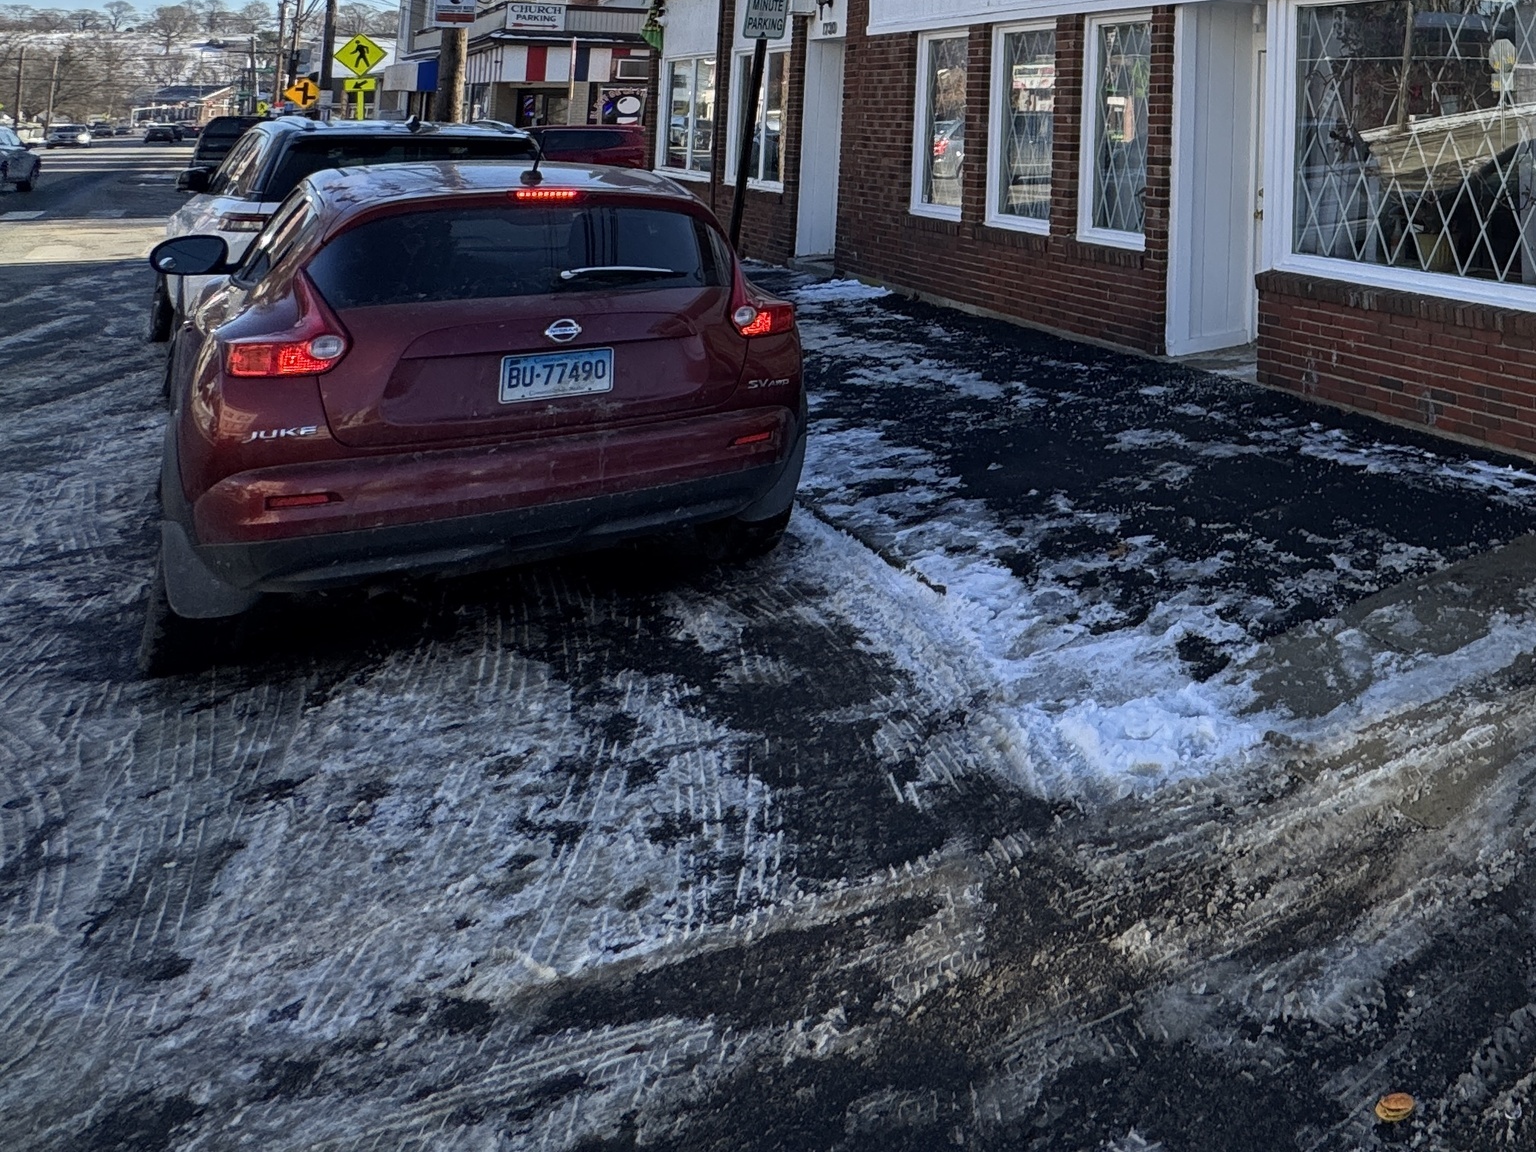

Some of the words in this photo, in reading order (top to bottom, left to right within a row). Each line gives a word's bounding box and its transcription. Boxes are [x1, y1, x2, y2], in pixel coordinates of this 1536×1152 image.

[511, 4, 562, 15] CHURCH
[516, 14, 557, 22] PARKING
[747, 16, 783, 31] PARKING
[747, 378, 769, 389] SV
[241, 425, 318, 444] JUKE
